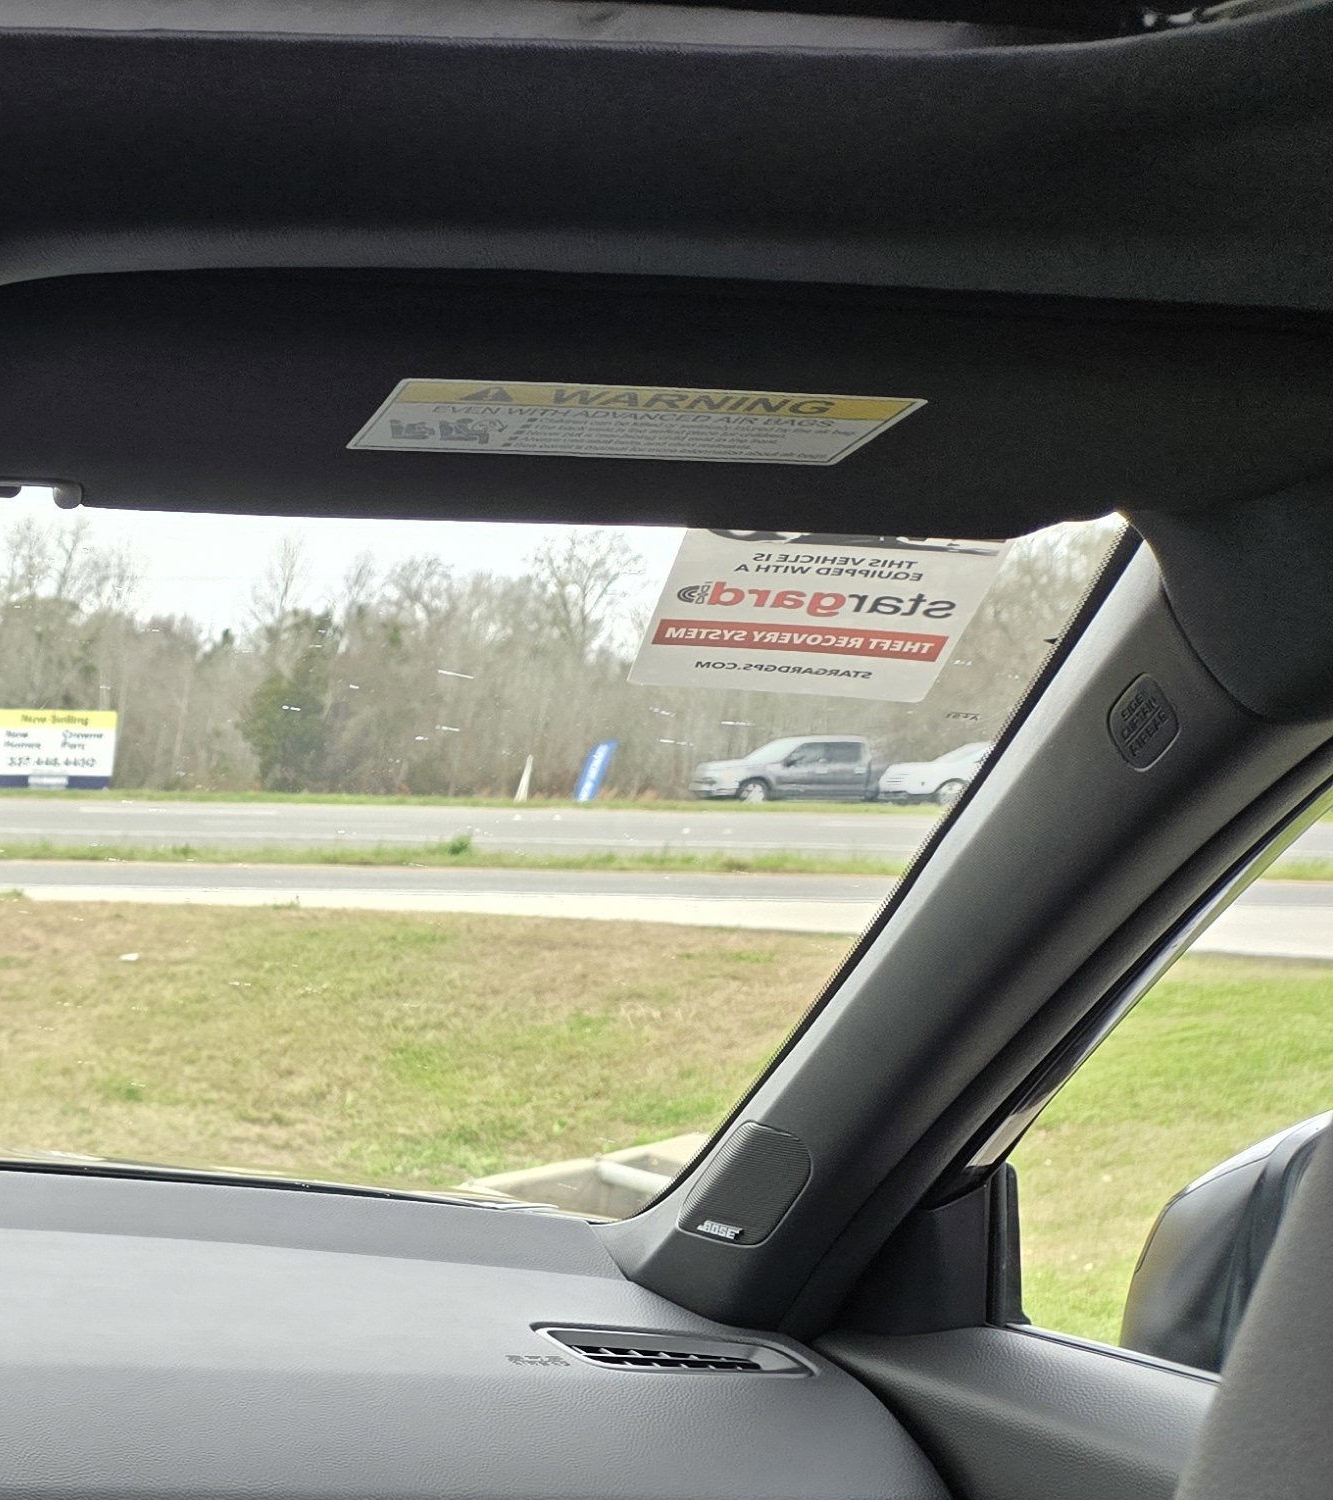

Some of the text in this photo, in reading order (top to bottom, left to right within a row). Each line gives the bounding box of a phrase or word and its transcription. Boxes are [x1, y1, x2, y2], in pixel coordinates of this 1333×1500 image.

[550, 388, 835, 415] WARNING
[432, 405, 501, 415] EVEN
[507, 406, 578, 417] WITH
[575, 409, 711, 422] ADVANCED
[718, 415, 756, 425] AIR
[763, 417, 836, 428] BAGS
[697, 1220, 744, 1240] BOSE
